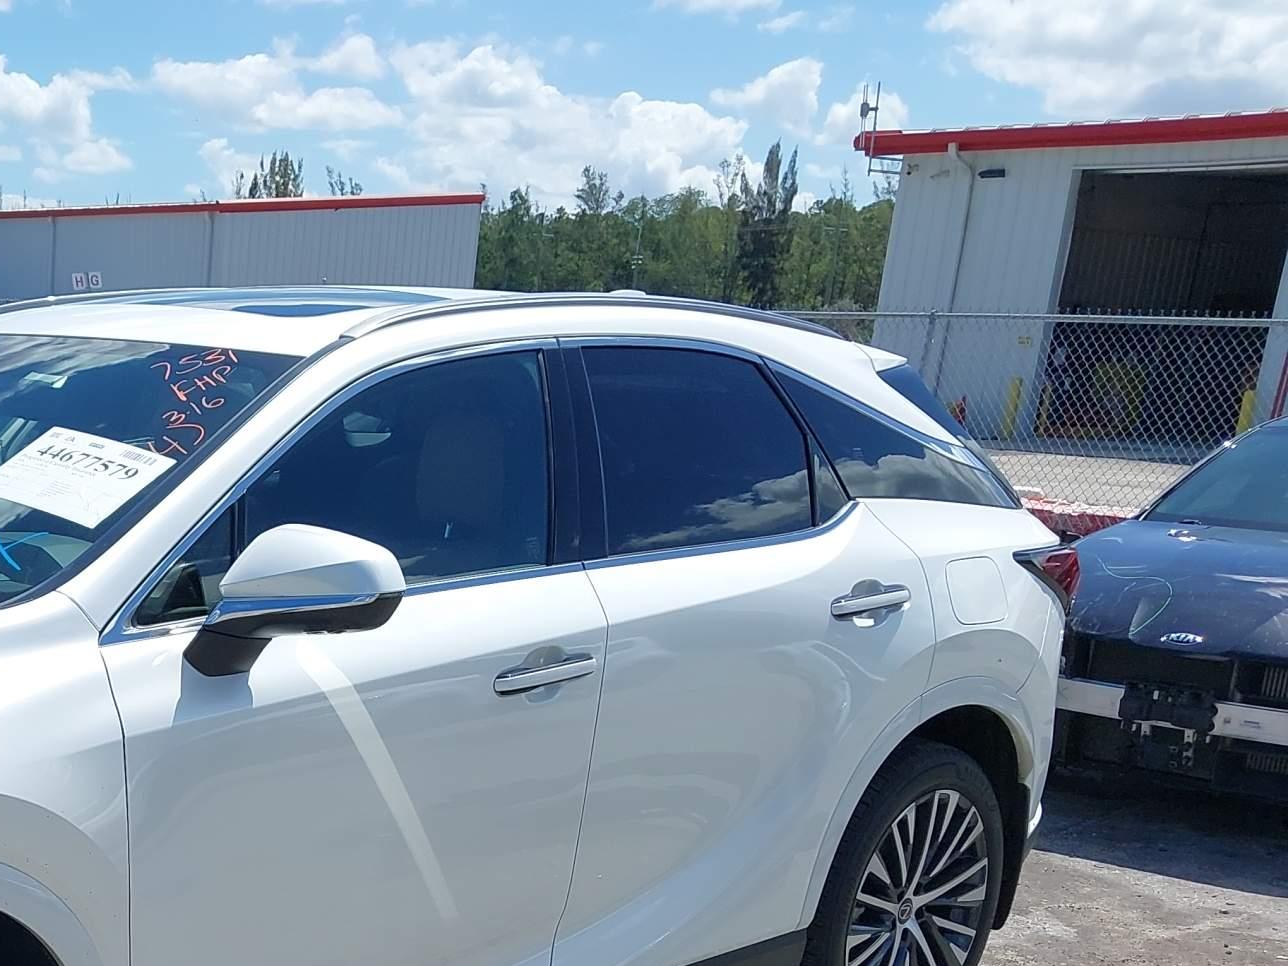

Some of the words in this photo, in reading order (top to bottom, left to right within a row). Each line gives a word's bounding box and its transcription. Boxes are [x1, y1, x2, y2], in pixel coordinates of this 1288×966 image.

[74, 275, 84, 288] H
[91, 274, 100, 286] G
[150, 348, 238, 380] 7531
[36, 444, 139, 480] 44677579
